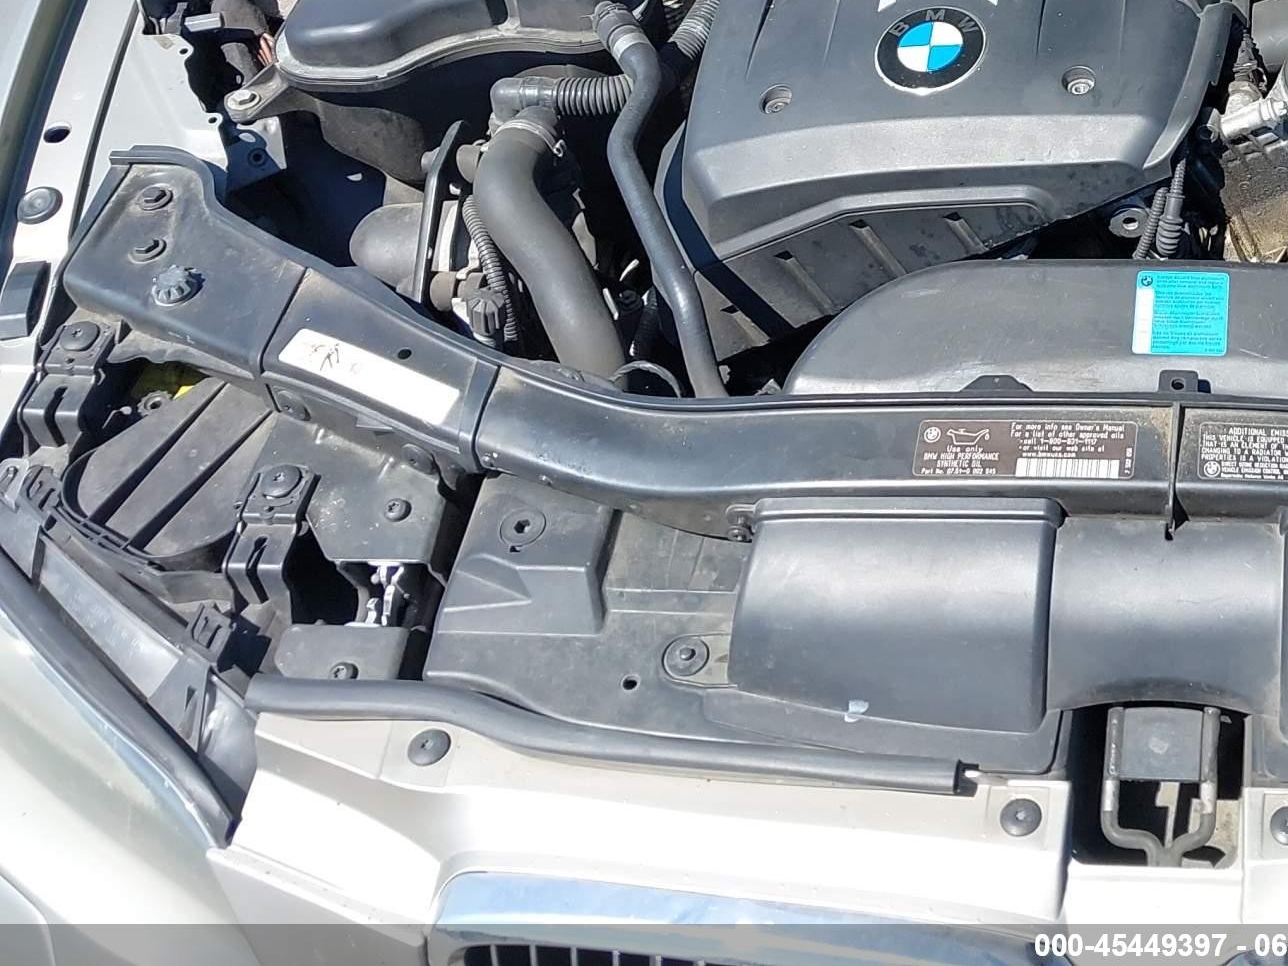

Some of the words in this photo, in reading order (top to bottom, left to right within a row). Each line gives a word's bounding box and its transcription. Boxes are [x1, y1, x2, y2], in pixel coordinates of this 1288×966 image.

[889, 10, 980, 36] BMW
[1076, 423, 1099, 431] Owner's
[1059, 430, 1076, 438] other
[1080, 431, 1108, 439] approved
[966, 445, 983, 453] only
